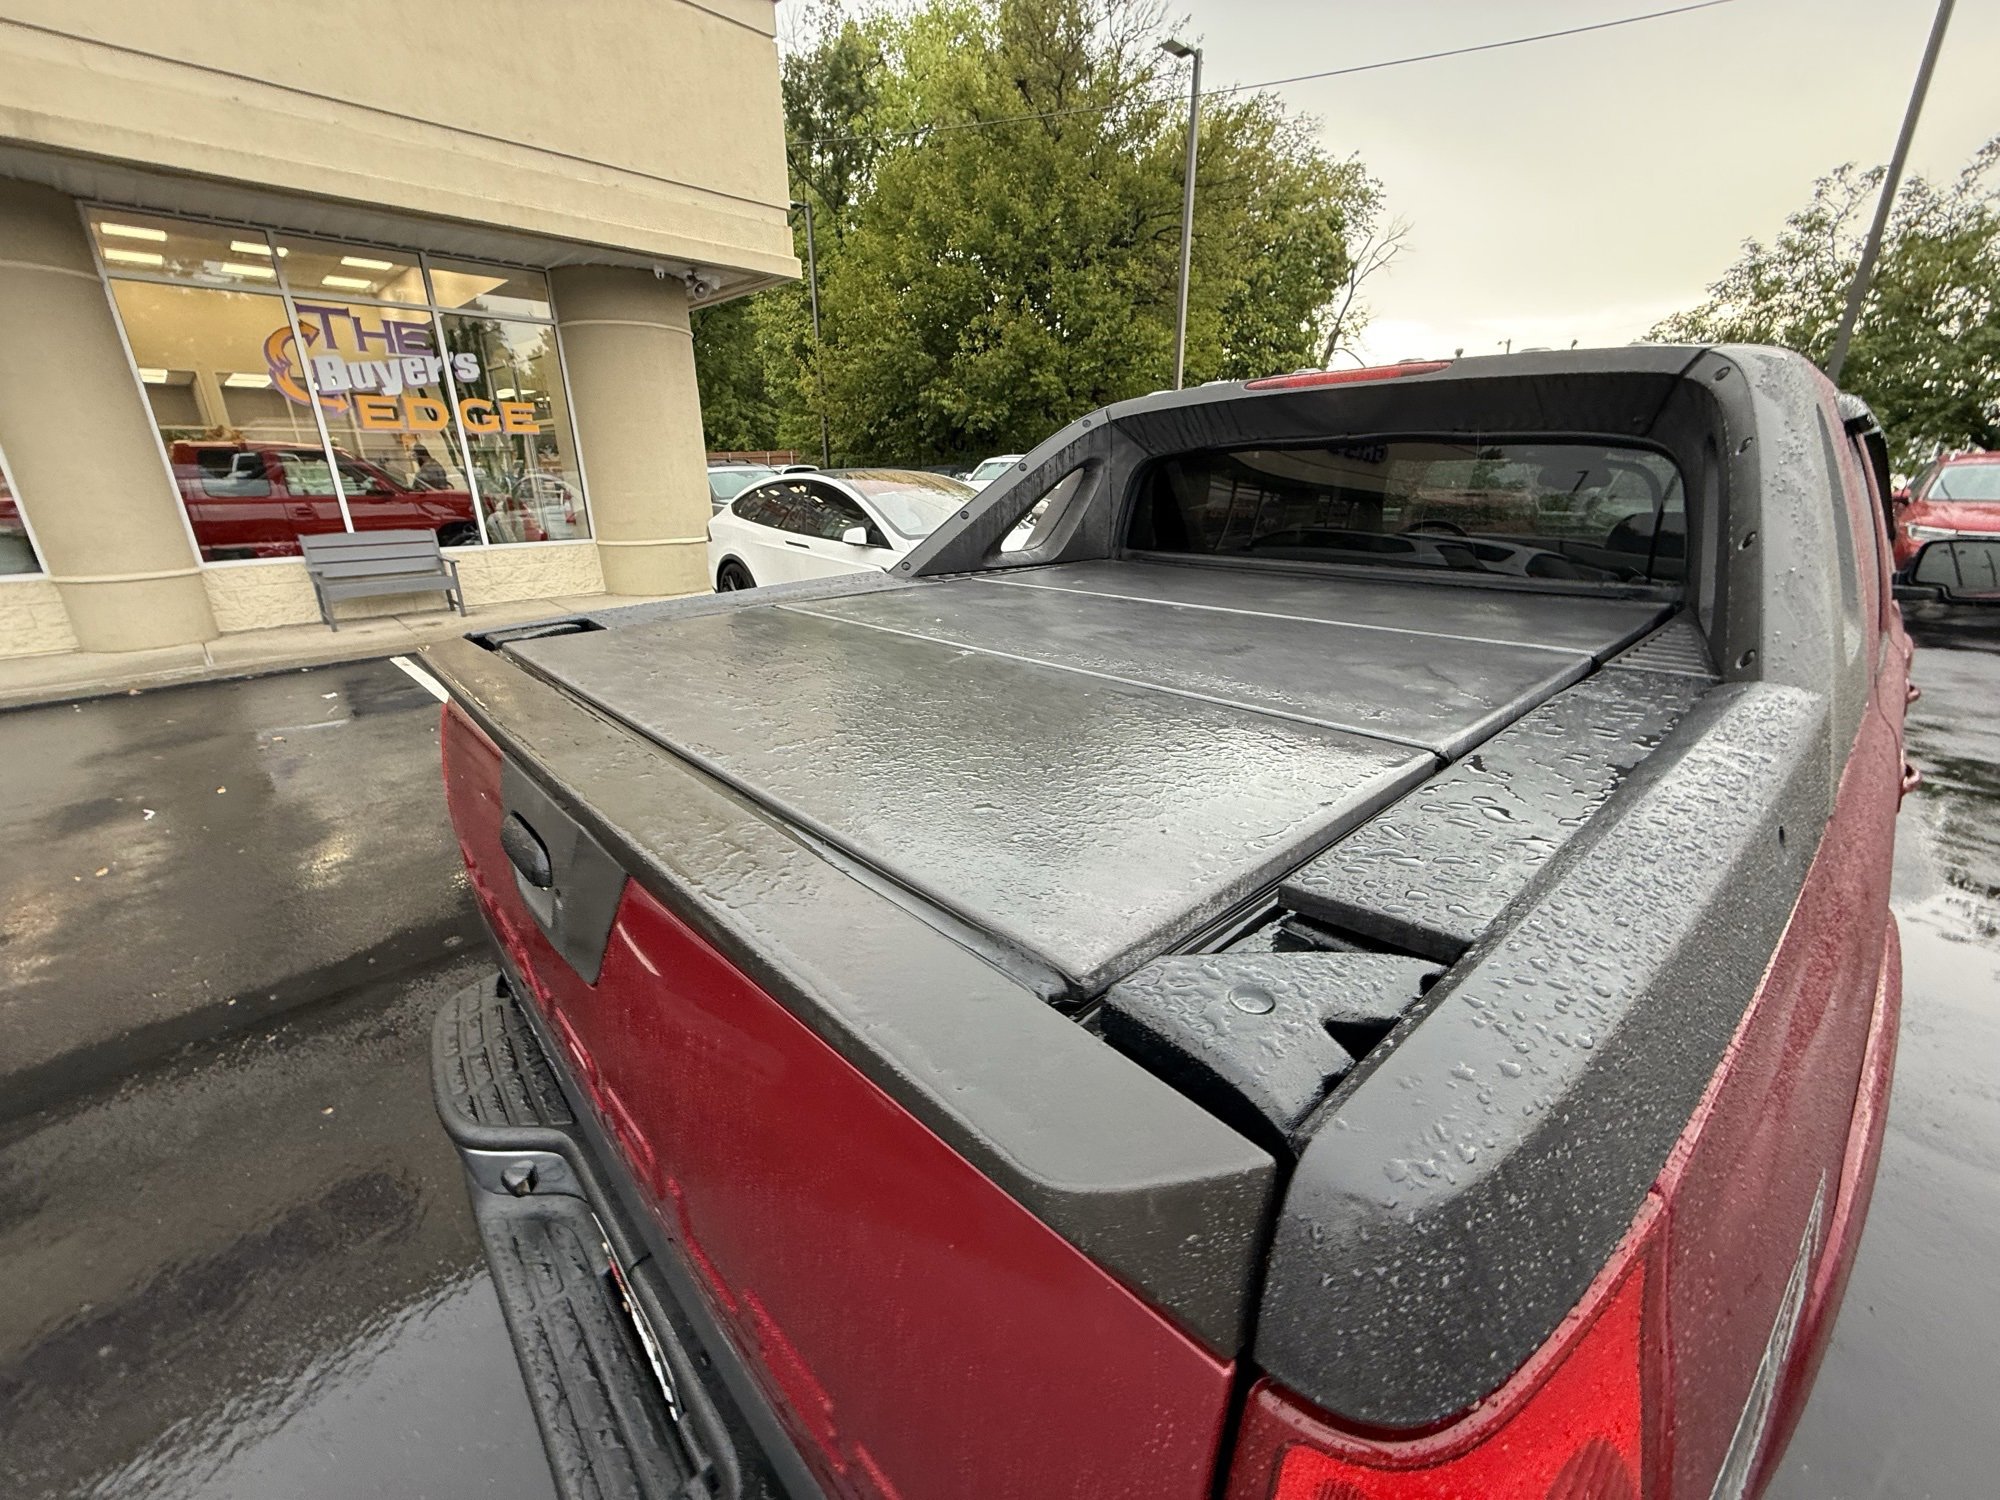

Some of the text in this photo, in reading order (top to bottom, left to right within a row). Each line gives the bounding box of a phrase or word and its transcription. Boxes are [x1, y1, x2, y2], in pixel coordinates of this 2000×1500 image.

[294, 302, 433, 357] THE
[313, 352, 481, 396] Buyer's
[356, 395, 540, 435] EDGE
